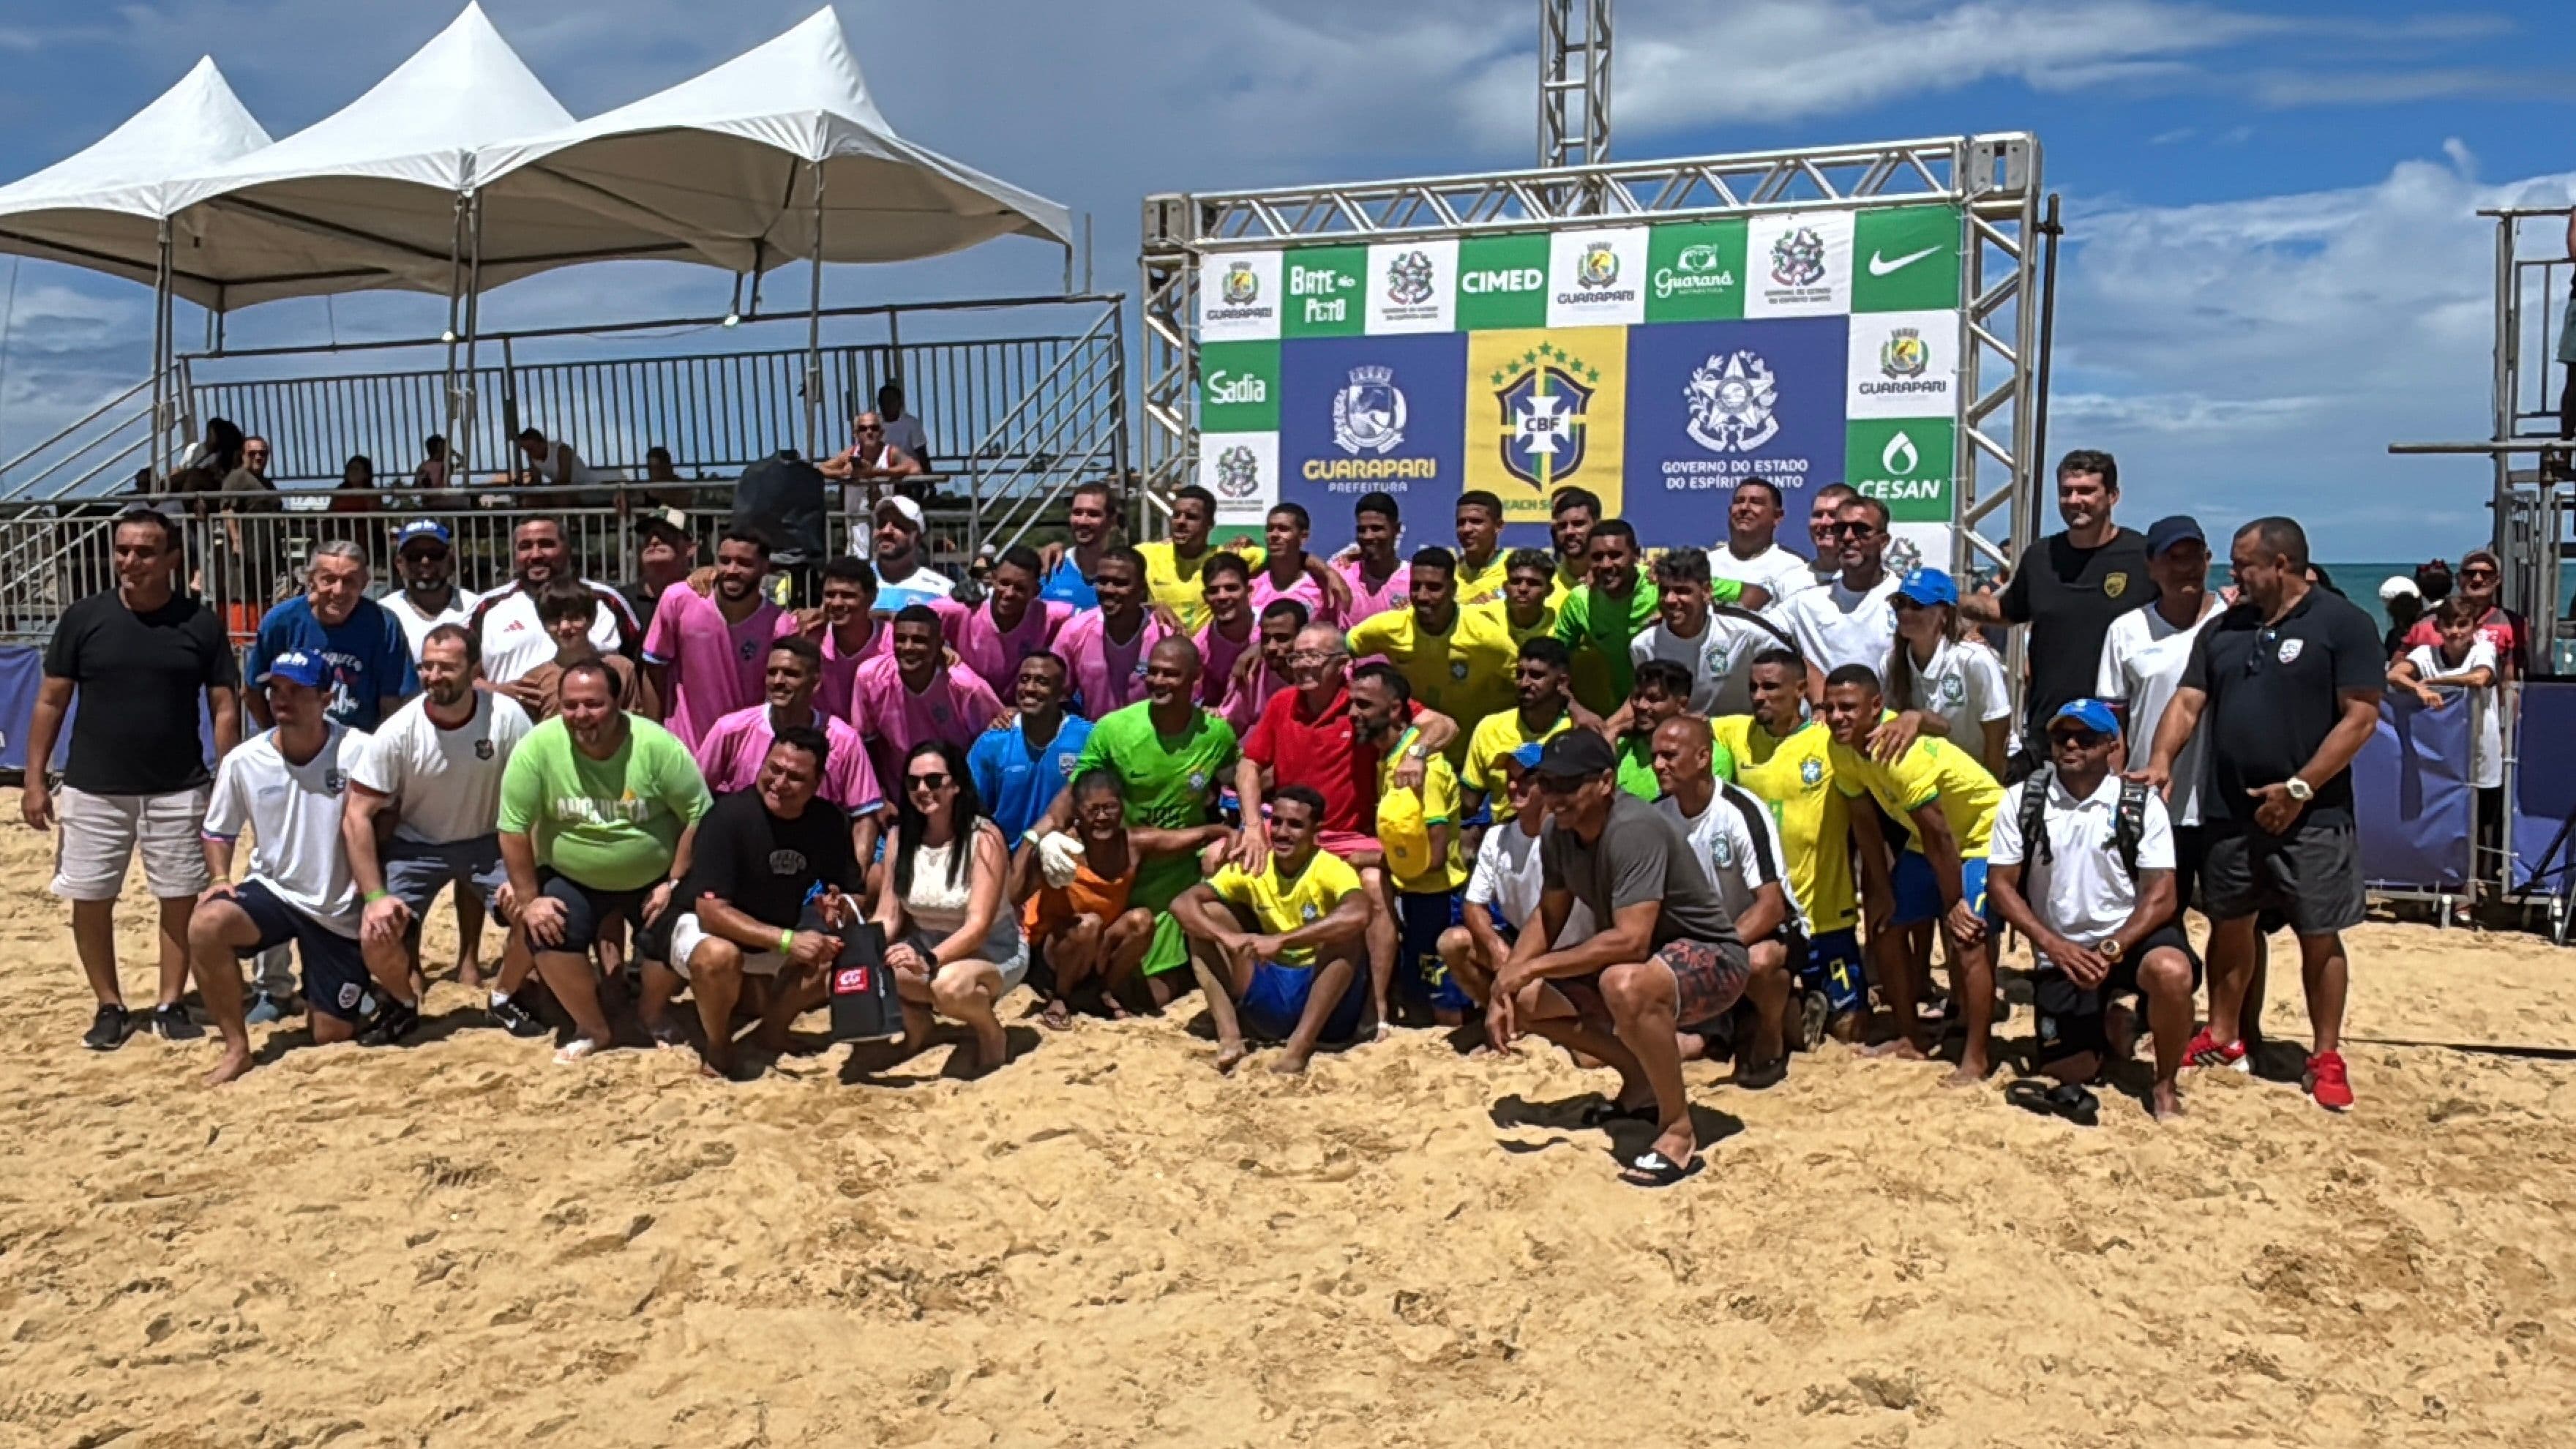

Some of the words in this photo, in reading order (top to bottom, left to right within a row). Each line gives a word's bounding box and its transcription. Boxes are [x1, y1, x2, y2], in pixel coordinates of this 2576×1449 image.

[1462, 269, 1543, 293] CIMED
[1654, 268, 1734, 299] Guaraná
[1557, 290, 1635, 304] GUARAPARI
[1208, 370, 1267, 404] Sadia
[1859, 381, 1947, 395] GUARAPARI
[1525, 416, 1561, 432] CBF
[1302, 457, 1437, 480] GUARAPARI
[1662, 460, 1727, 474] GOVERNO
[1730, 460, 1751, 473] DO
[1754, 458, 1809, 473] ESTADO
[1328, 481, 1408, 493] PREFEITURA
[1666, 476, 1686, 490] DO
[1689, 474, 1749, 489] ESPÍRIT
[1759, 476, 1804, 488] ANTO
[1857, 479, 1941, 499] CESAN
